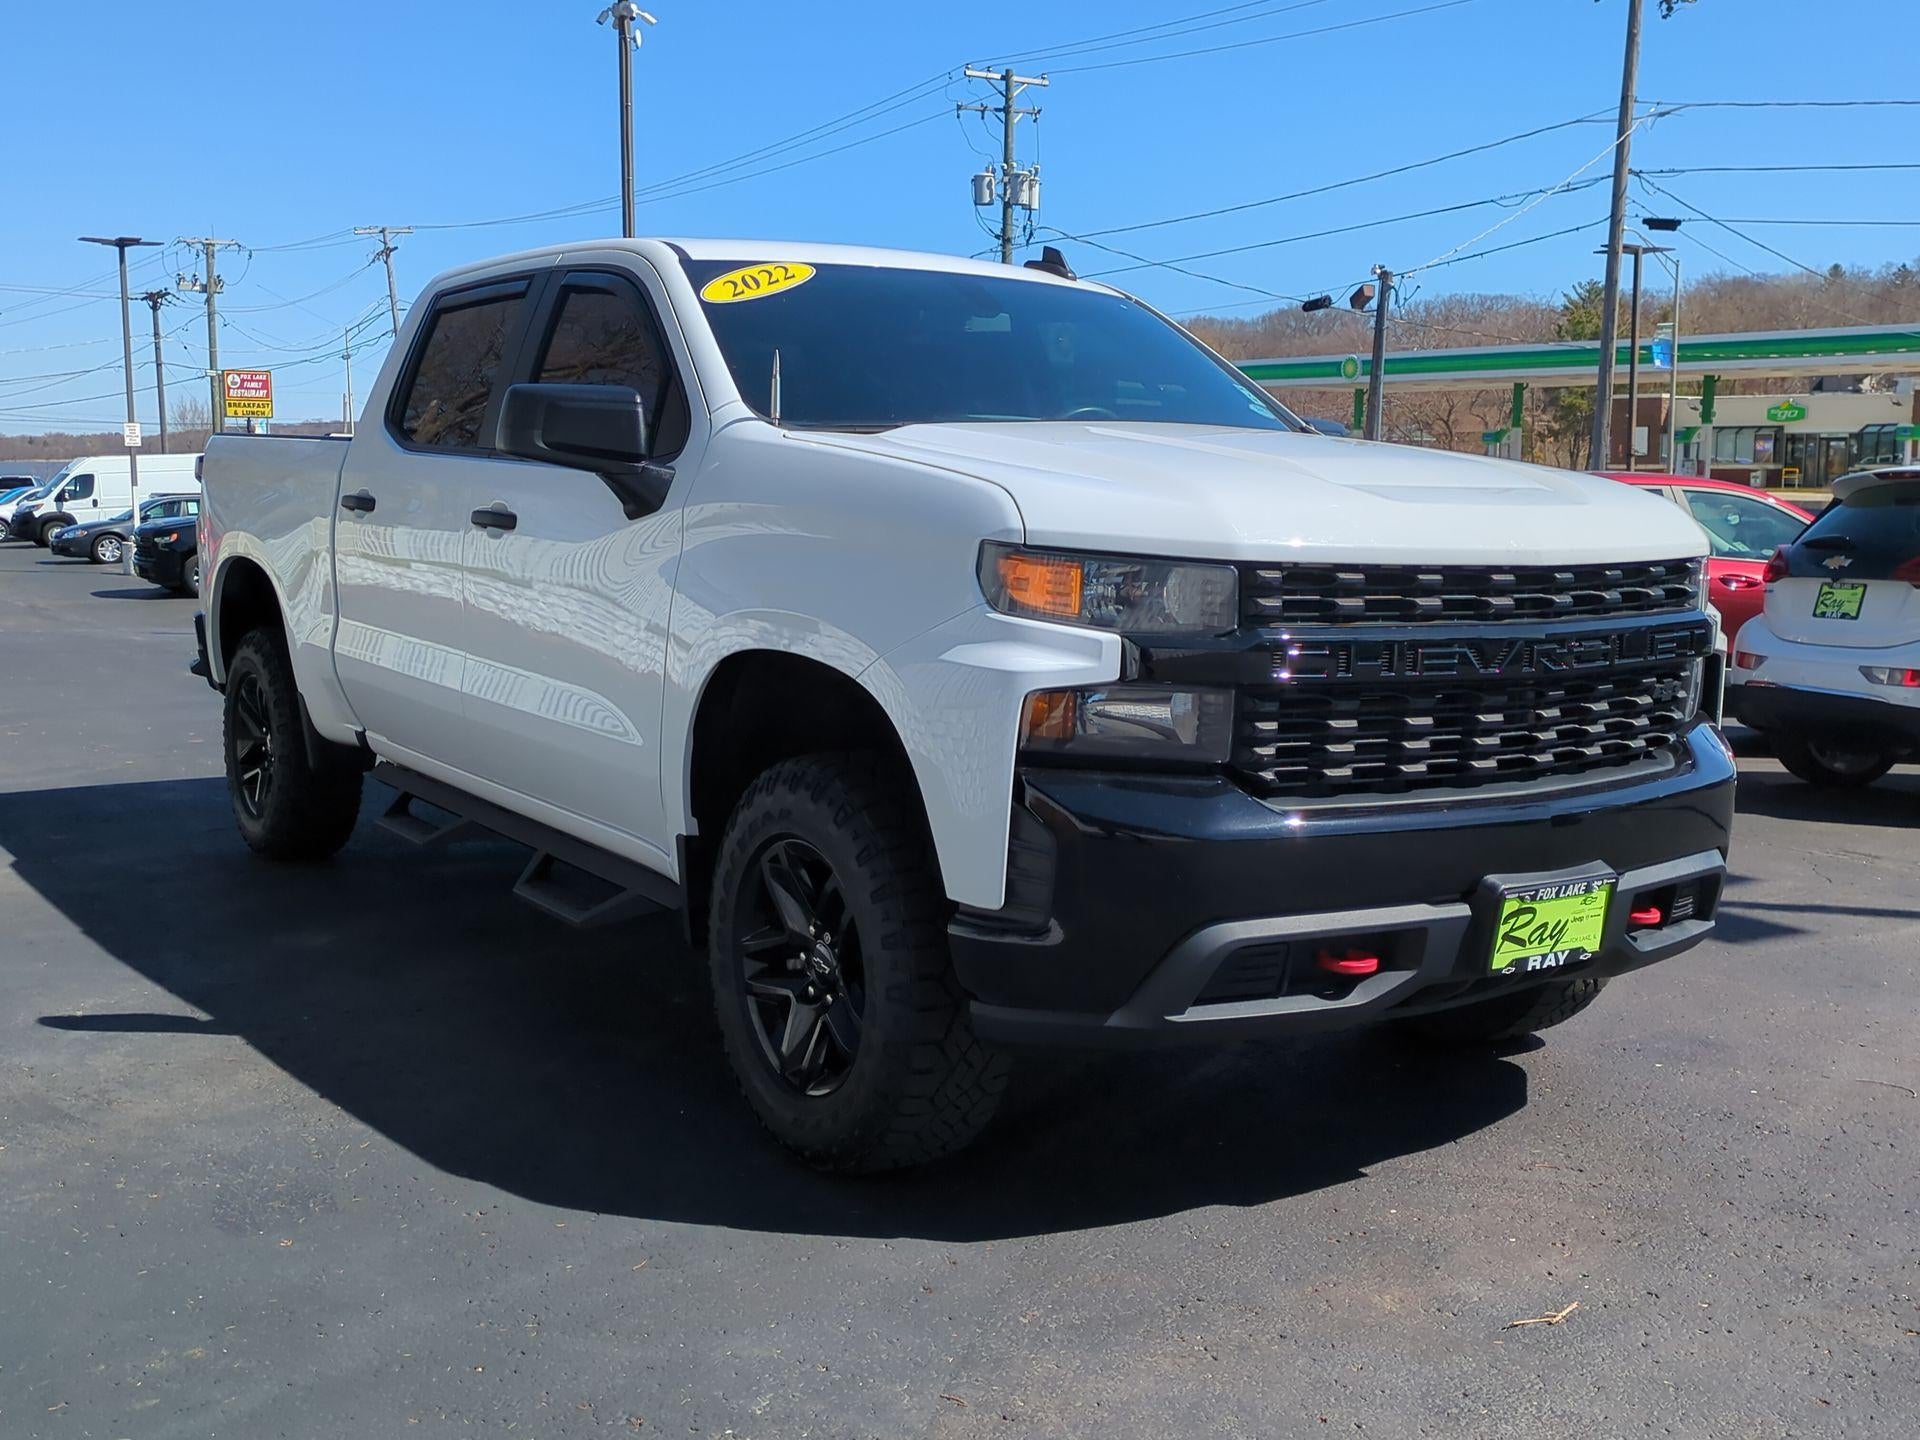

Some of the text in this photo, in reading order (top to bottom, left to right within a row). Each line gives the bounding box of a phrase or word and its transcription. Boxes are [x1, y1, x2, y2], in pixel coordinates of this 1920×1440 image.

[722, 265, 796, 298] 2022
[229, 389, 267, 397] RESTAURANT
[227, 401, 270, 409] BREAKFAST
[1820, 591, 1845, 612] Ray
[1271, 628, 1707, 679] CHEVROLET
[1536, 886, 1559, 901] FOX
[1559, 882, 1588, 898] LAKE
[1496, 906, 1570, 954] Ray
[1527, 950, 1570, 971] RAY
